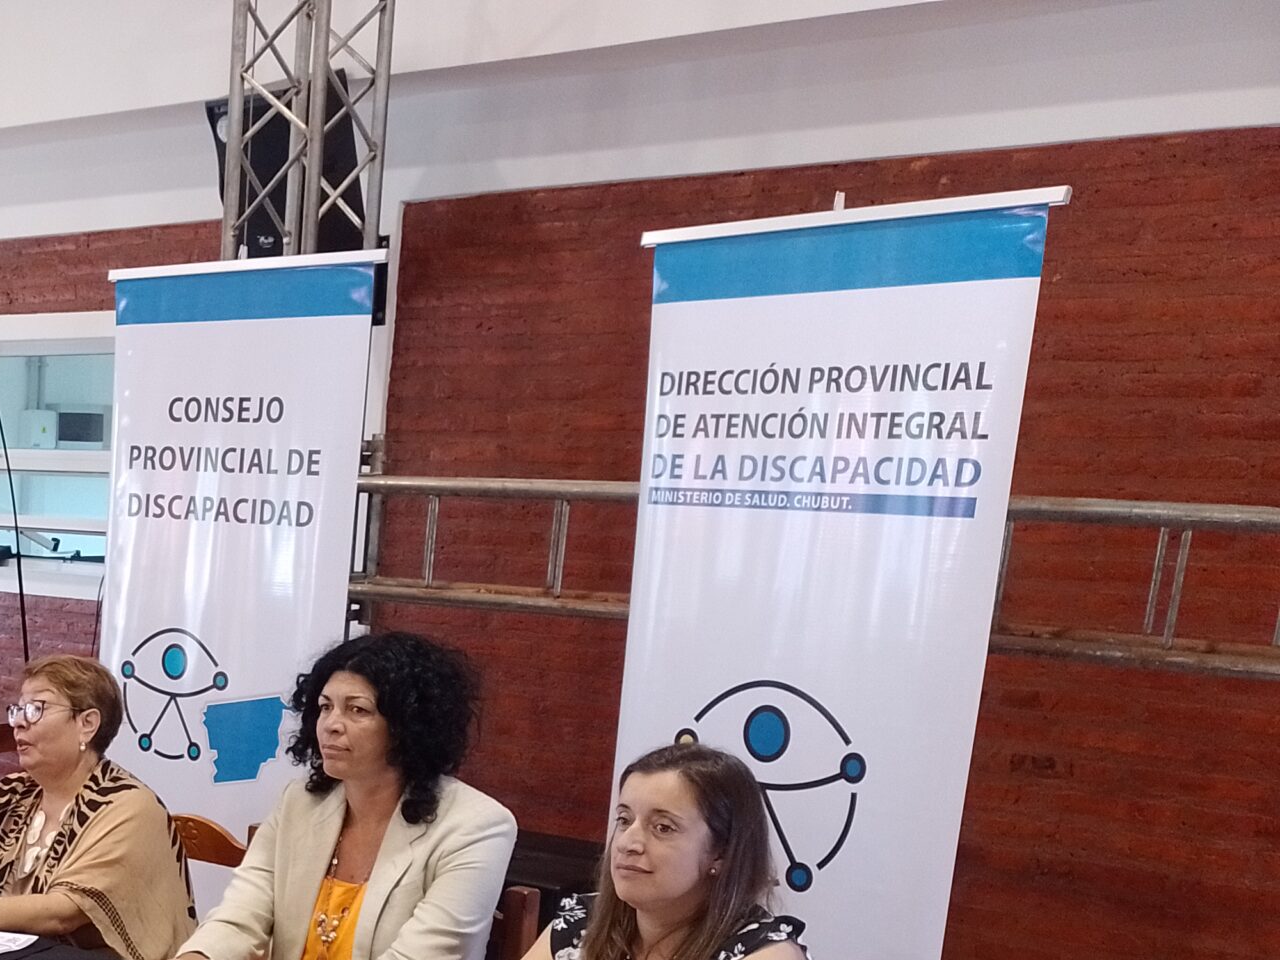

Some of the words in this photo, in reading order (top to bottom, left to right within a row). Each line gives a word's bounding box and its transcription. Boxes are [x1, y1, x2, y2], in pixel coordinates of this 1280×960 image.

[659, 362, 801, 397] DIRECCIÓN
[808, 361, 993, 394] PROVINCIAL
[168, 396, 285, 424] CONSEJO
[655, 413, 687, 440] DE
[692, 407, 829, 440] ATENCIÓN
[835, 411, 989, 440] INTEGRAL
[128, 445, 279, 476] PROVINCIAL
[286, 449, 322, 476] DE
[651, 453, 685, 480] DE
[693, 454, 728, 481] LA
[737, 454, 983, 489] DISCAPACIDAD
[127, 492, 315, 528] DISCAPACIDAD
[651, 490, 722, 505] MINISTERIO
[724, 493, 742, 505] DE
[744, 493, 790, 508] SALUD.
[793, 495, 852, 510] CHUBUT.
